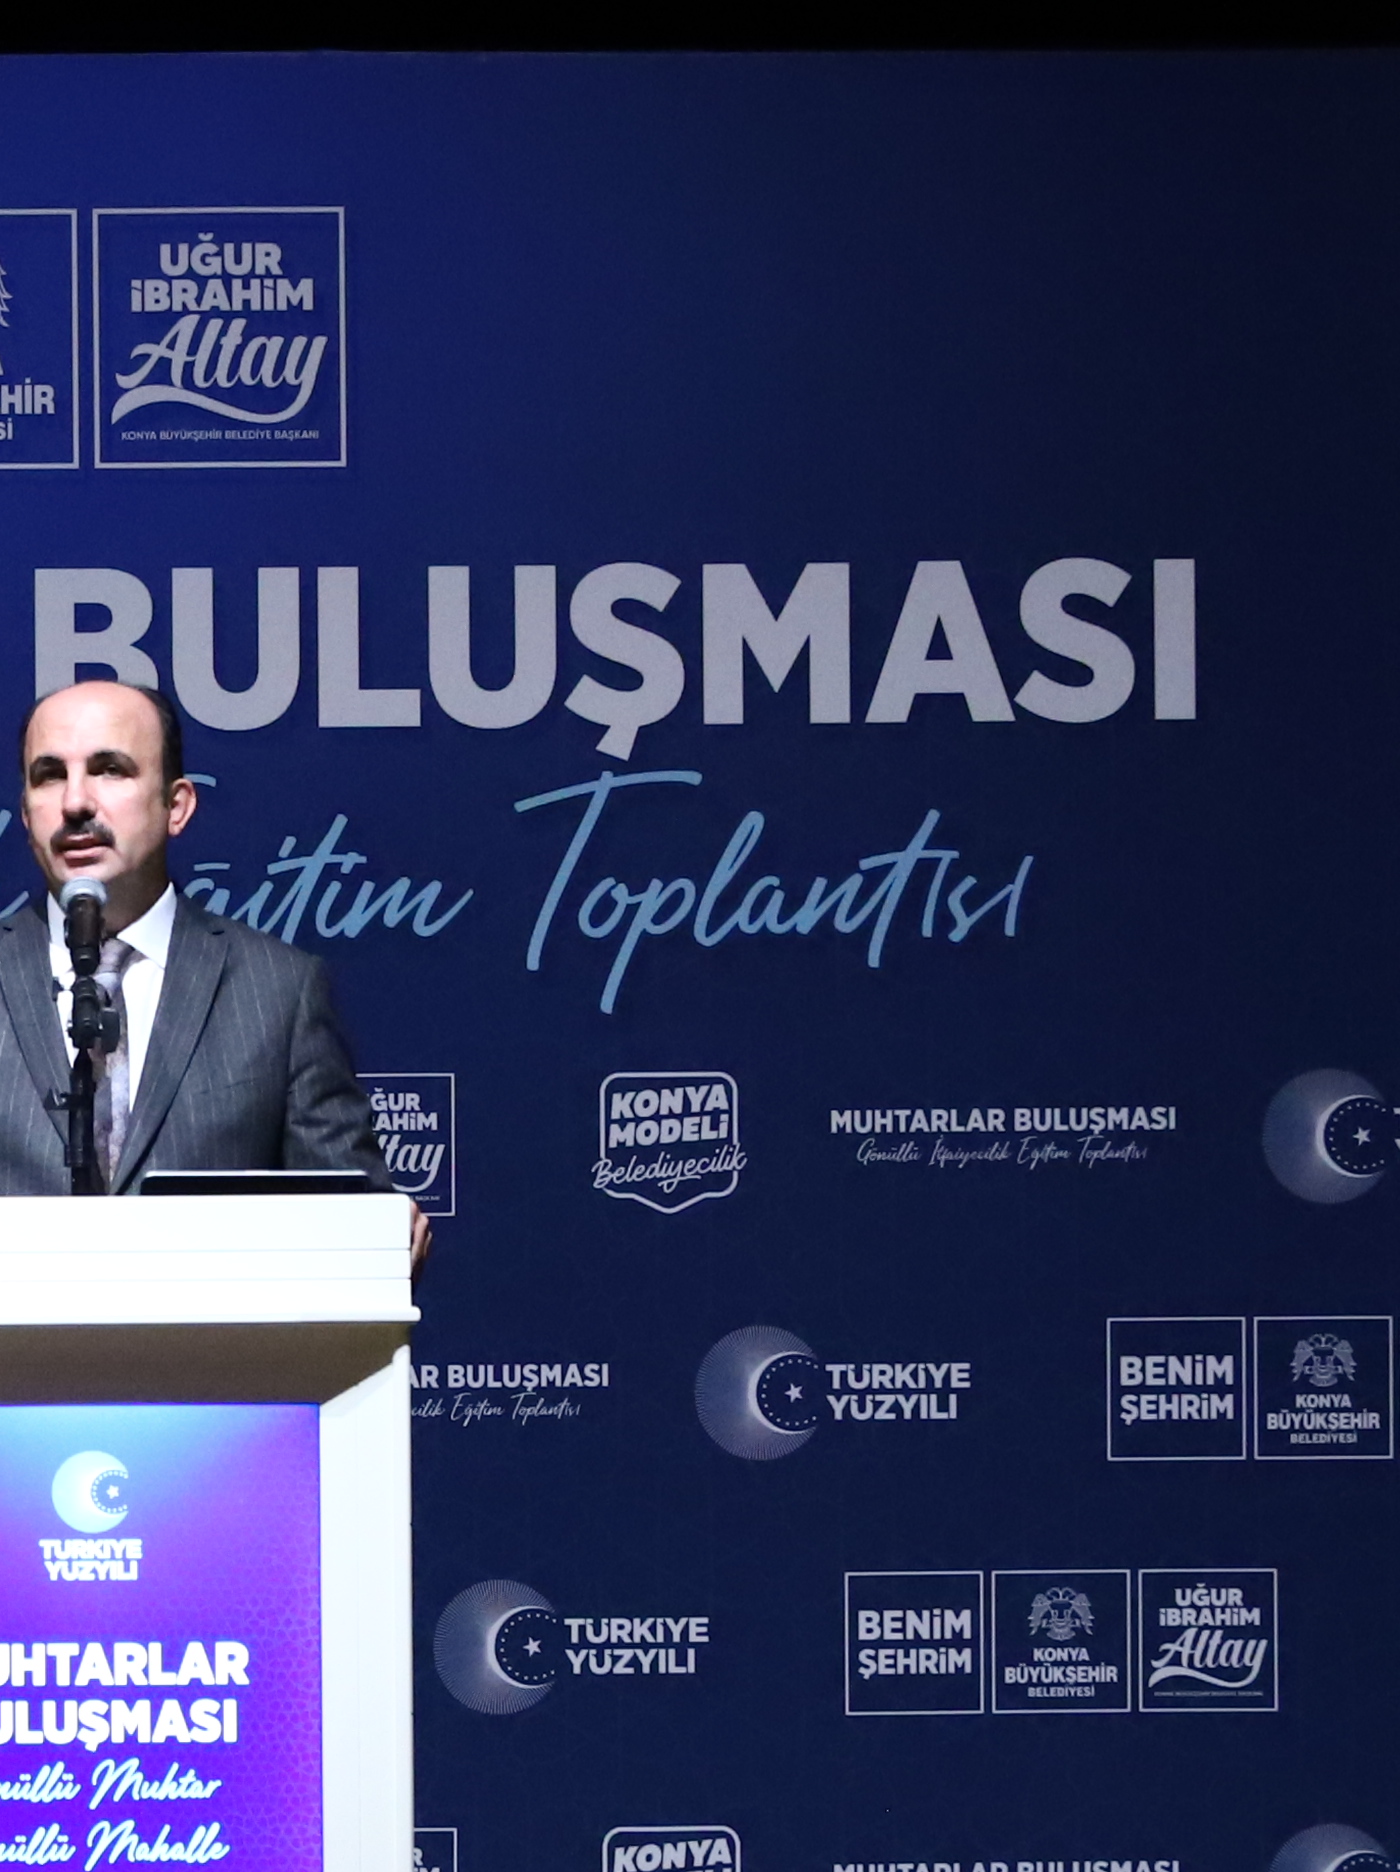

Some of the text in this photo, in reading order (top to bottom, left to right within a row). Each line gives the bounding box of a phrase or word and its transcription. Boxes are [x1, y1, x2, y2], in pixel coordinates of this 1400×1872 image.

[160, 233, 282, 276] UĞUR
[112, 314, 327, 424] Altay
[122, 431, 156, 440] KONYA
[34, 557, 1197, 760] BULUŞMASI
[514, 771, 1033, 1014] Toplantısı
[367, 1087, 421, 1112] ĞUR
[609, 1084, 727, 1119] KONYA
[831, 1107, 1175, 1135] MUHTARLAR BULUŞMASI
[591, 1143, 747, 1193] Belediyecilik
[448, 1363, 608, 1392] BULUŞMASI
[1296, 1394, 1351, 1408] KONYA
[1267, 1409, 1380, 1430] BÜYÜKŞEHİR
[1175, 1583, 1243, 1606] UĞUR
[1005, 1662, 1117, 1684] BÜYÜKŞEHİR
[1034, 1648, 1089, 1664] KONYA
[1149, 1628, 1267, 1687] Altay
[89, 1757, 221, 1809] Muhtar
[85, 1819, 231, 1871] Mahalle
[613, 1838, 732, 1872] KONYA
